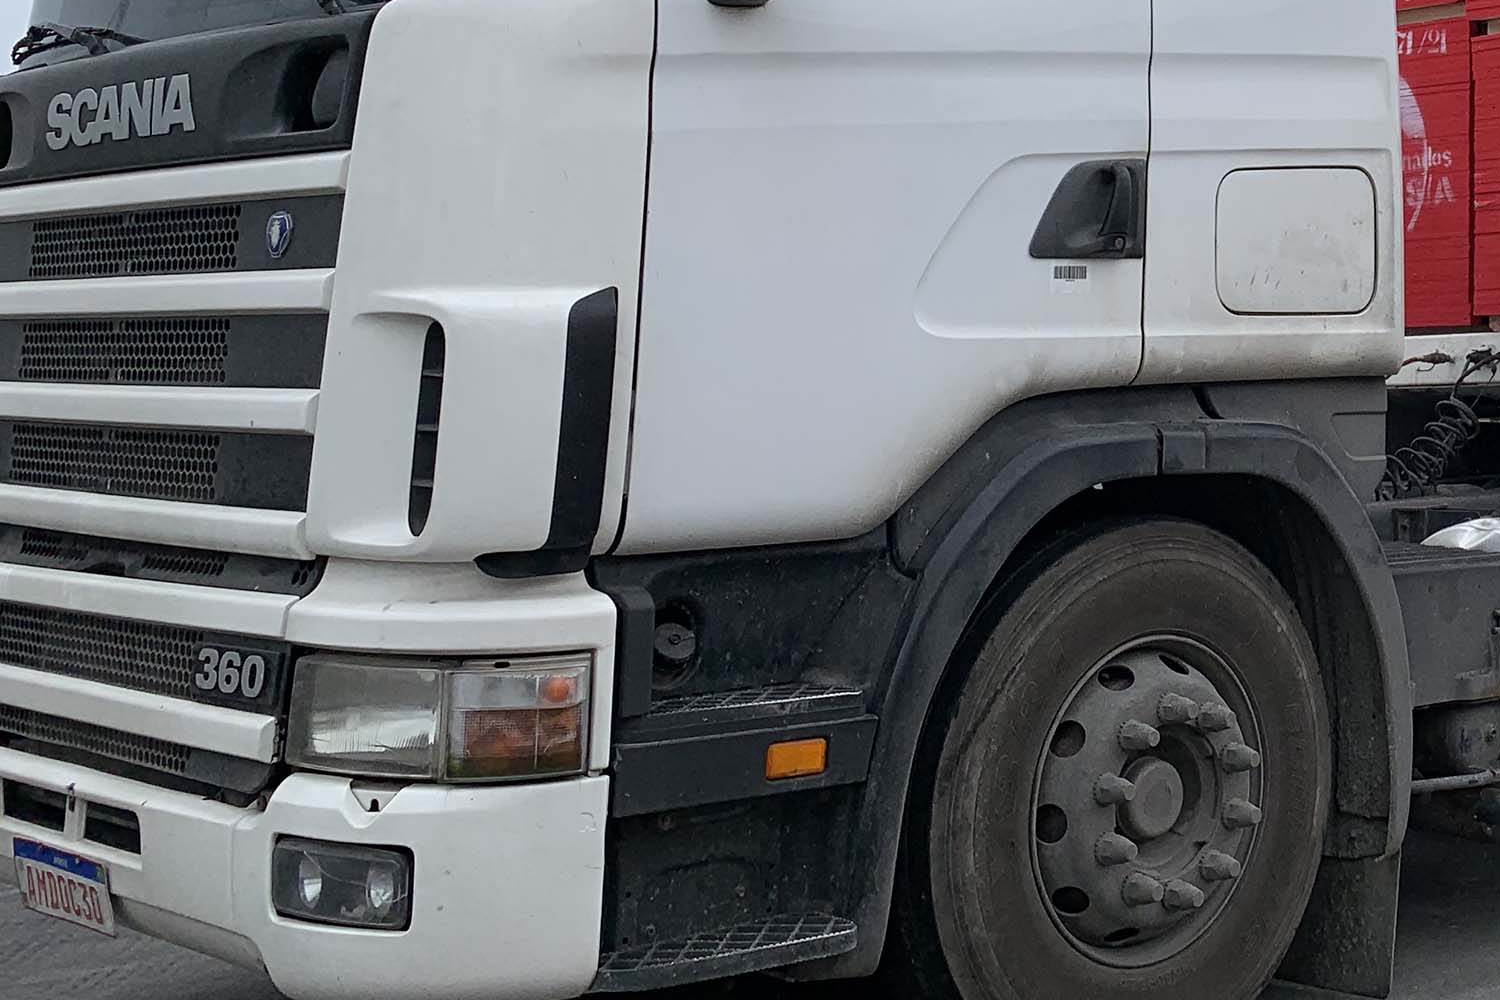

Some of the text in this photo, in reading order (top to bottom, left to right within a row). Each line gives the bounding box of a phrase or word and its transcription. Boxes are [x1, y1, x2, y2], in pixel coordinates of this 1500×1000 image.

[1398, 27, 1447, 56] 71/21
[46, 73, 196, 150] SCANIA
[195, 647, 265, 698] 360
